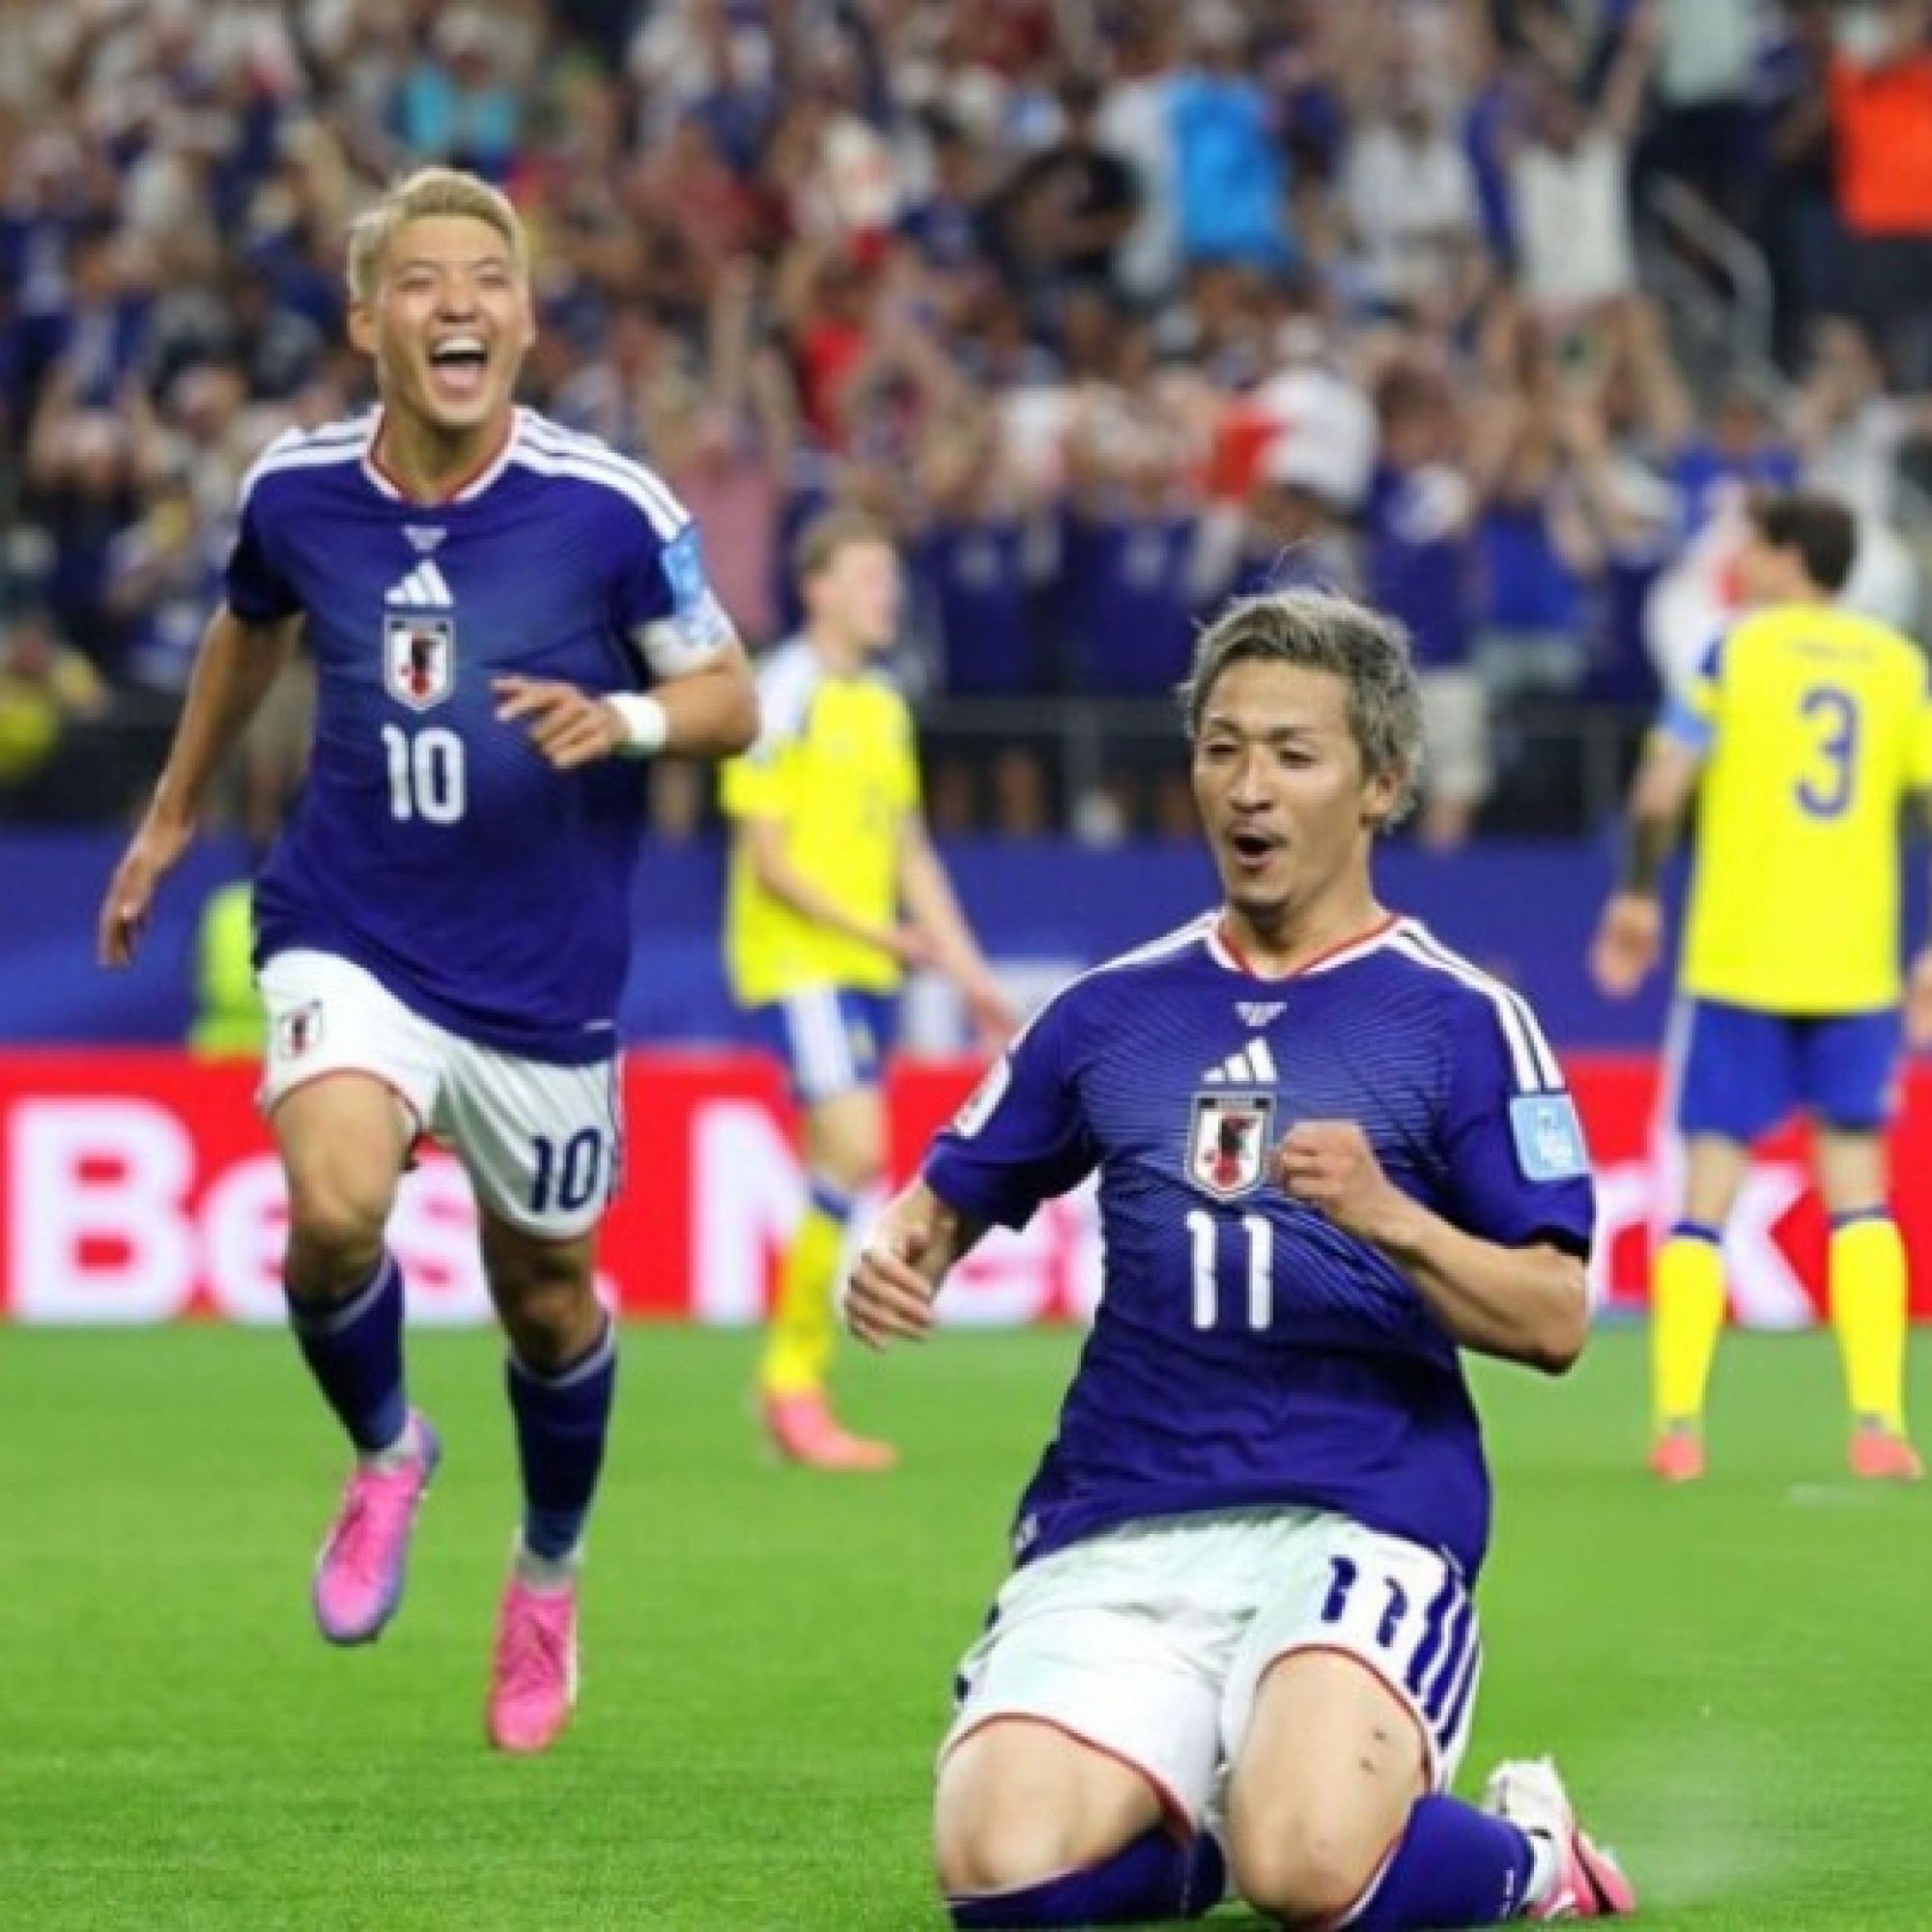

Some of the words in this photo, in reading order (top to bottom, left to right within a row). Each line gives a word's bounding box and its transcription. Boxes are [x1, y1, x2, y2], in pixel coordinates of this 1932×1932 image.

[381, 724, 466, 824] 10
[1793, 685, 1860, 820] 3
[12, 1095, 620, 1323] Bes
[528, 1127, 602, 1213] 10
[1186, 1209, 1273, 1329] 11
[1321, 1556, 1407, 1648] 11
